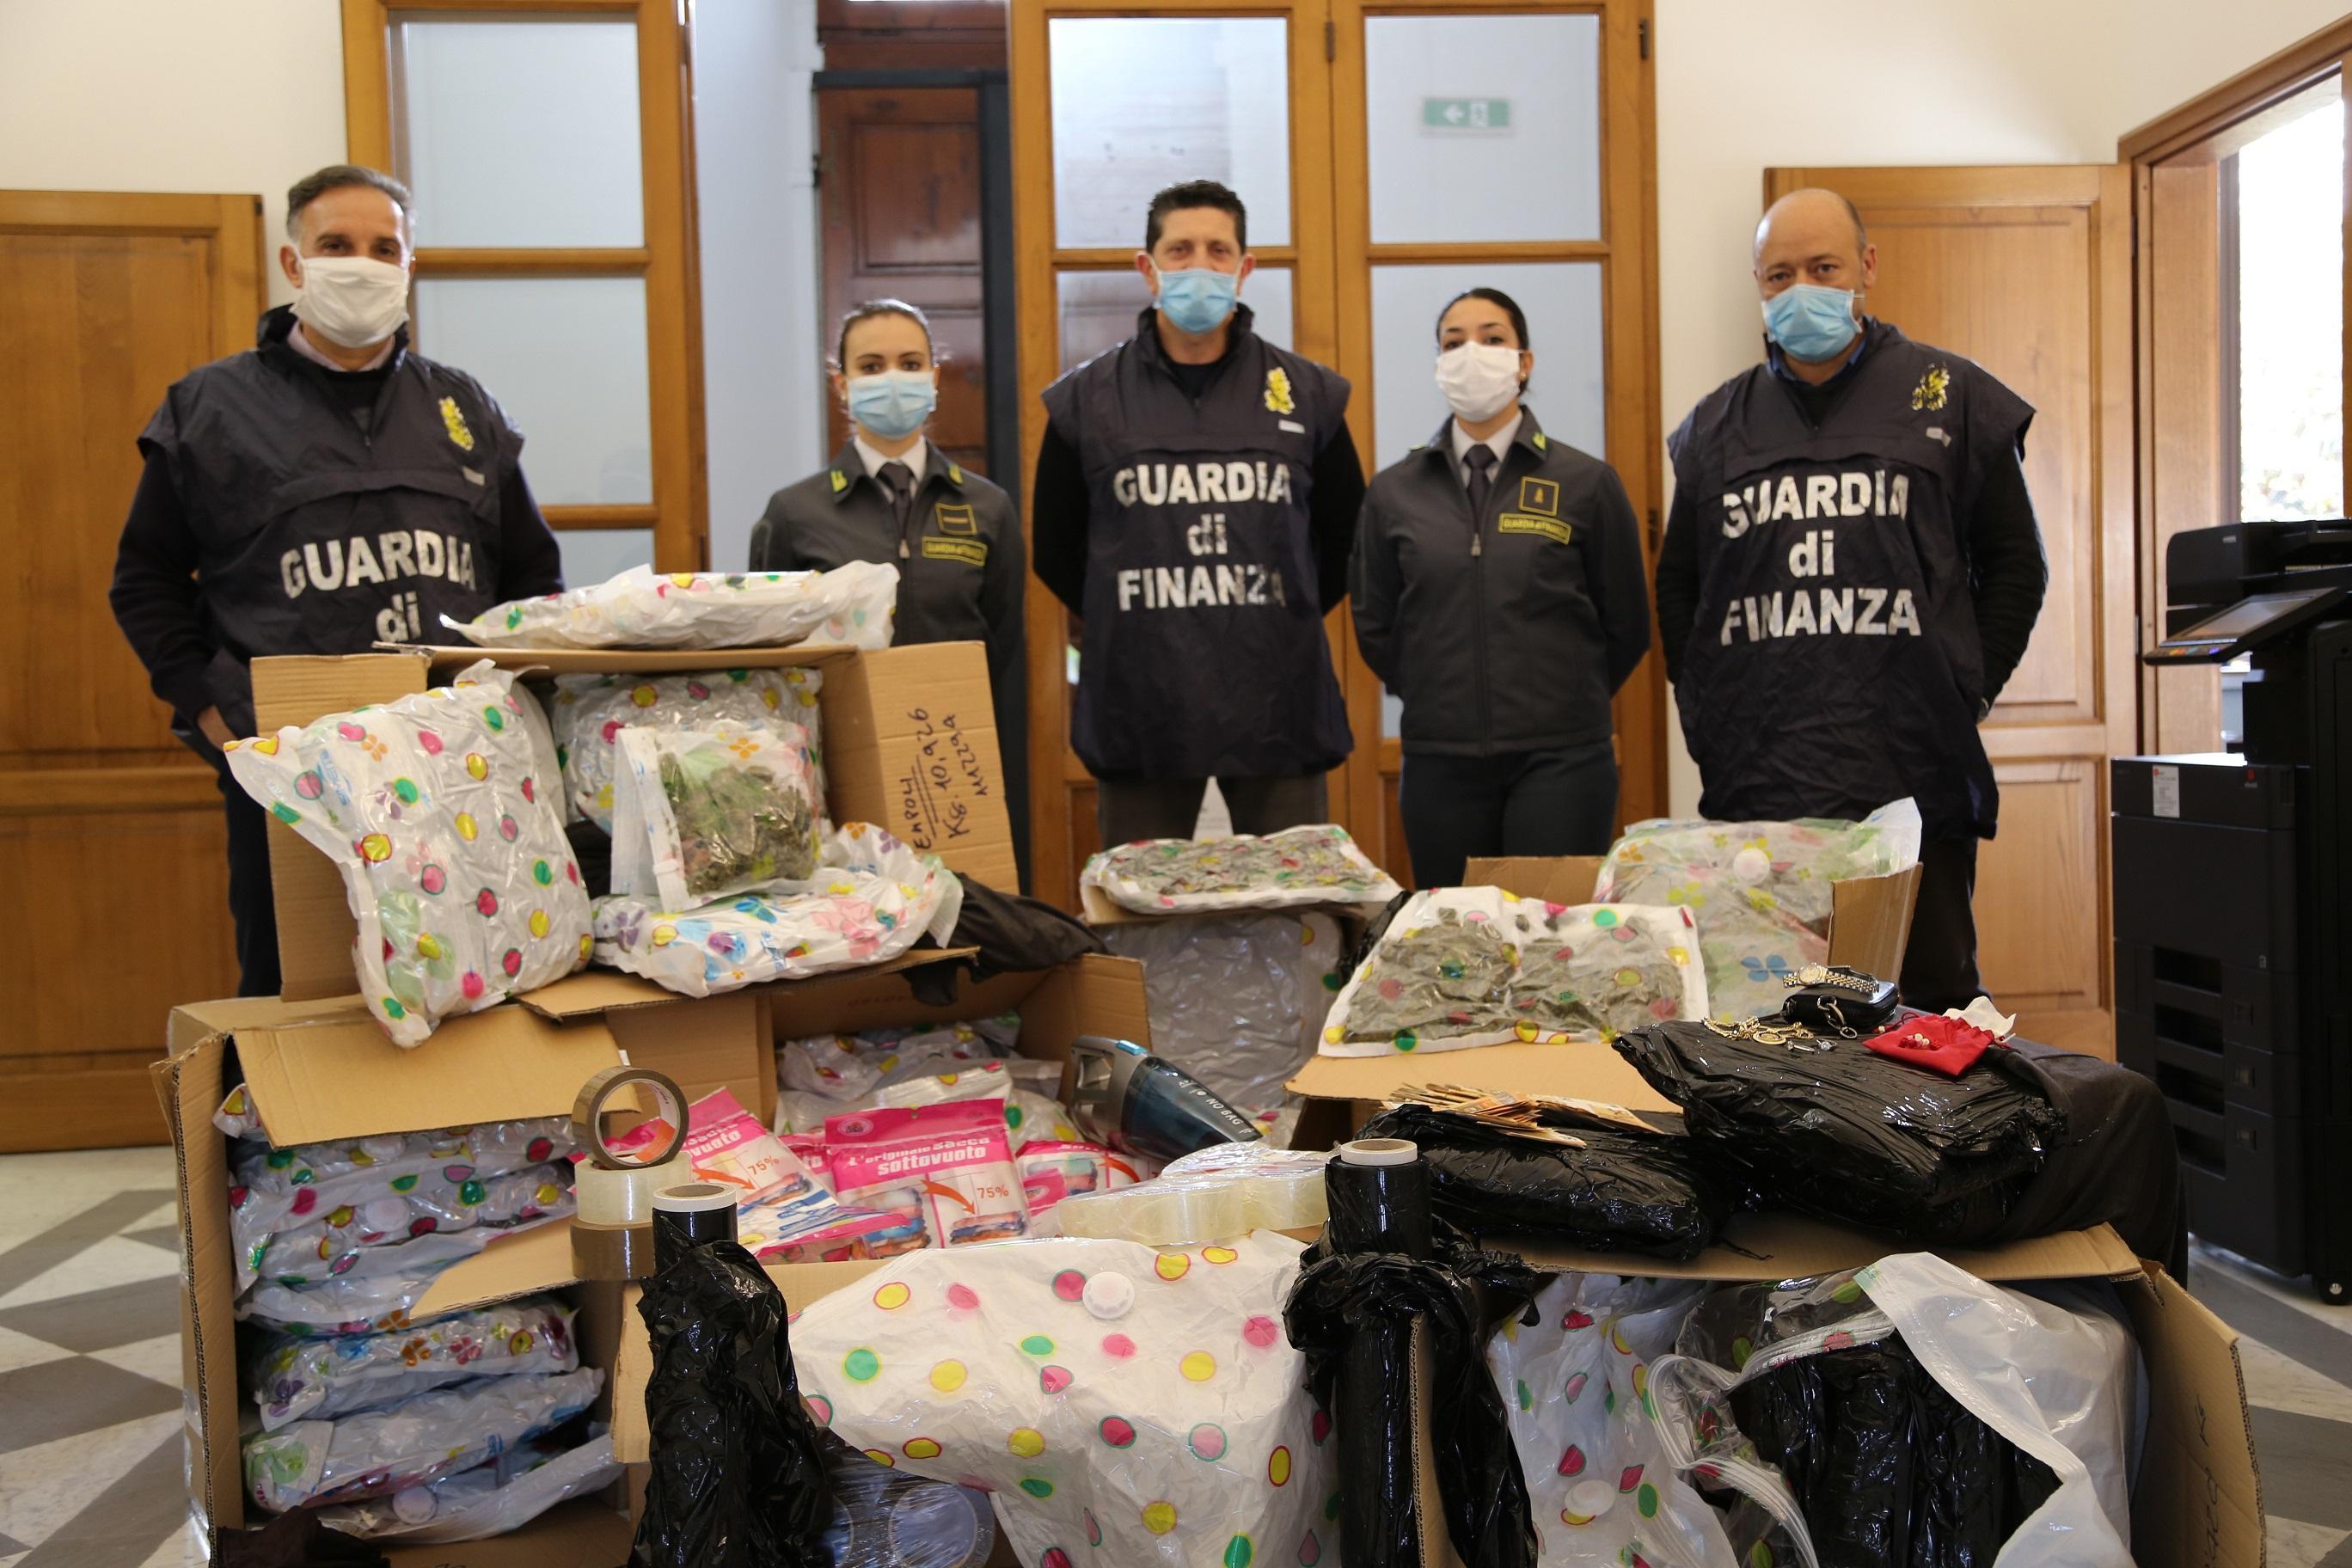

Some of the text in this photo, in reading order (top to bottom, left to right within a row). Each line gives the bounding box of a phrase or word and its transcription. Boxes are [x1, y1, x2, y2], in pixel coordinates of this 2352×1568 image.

[1113, 461, 1292, 507] GUARDIA
[1722, 469, 1909, 538] GUARDIA
[1186, 513, 1228, 556] di
[1789, 530, 1834, 578] di
[280, 529, 476, 599] GUARDIA
[376, 591, 421, 642] di
[1721, 587, 1922, 646] FINANZA
[1206, 1099, 1244, 1125] NO BAG
[747, 1155, 781, 1176] 75%
[977, 1185, 1009, 1199] 75%
